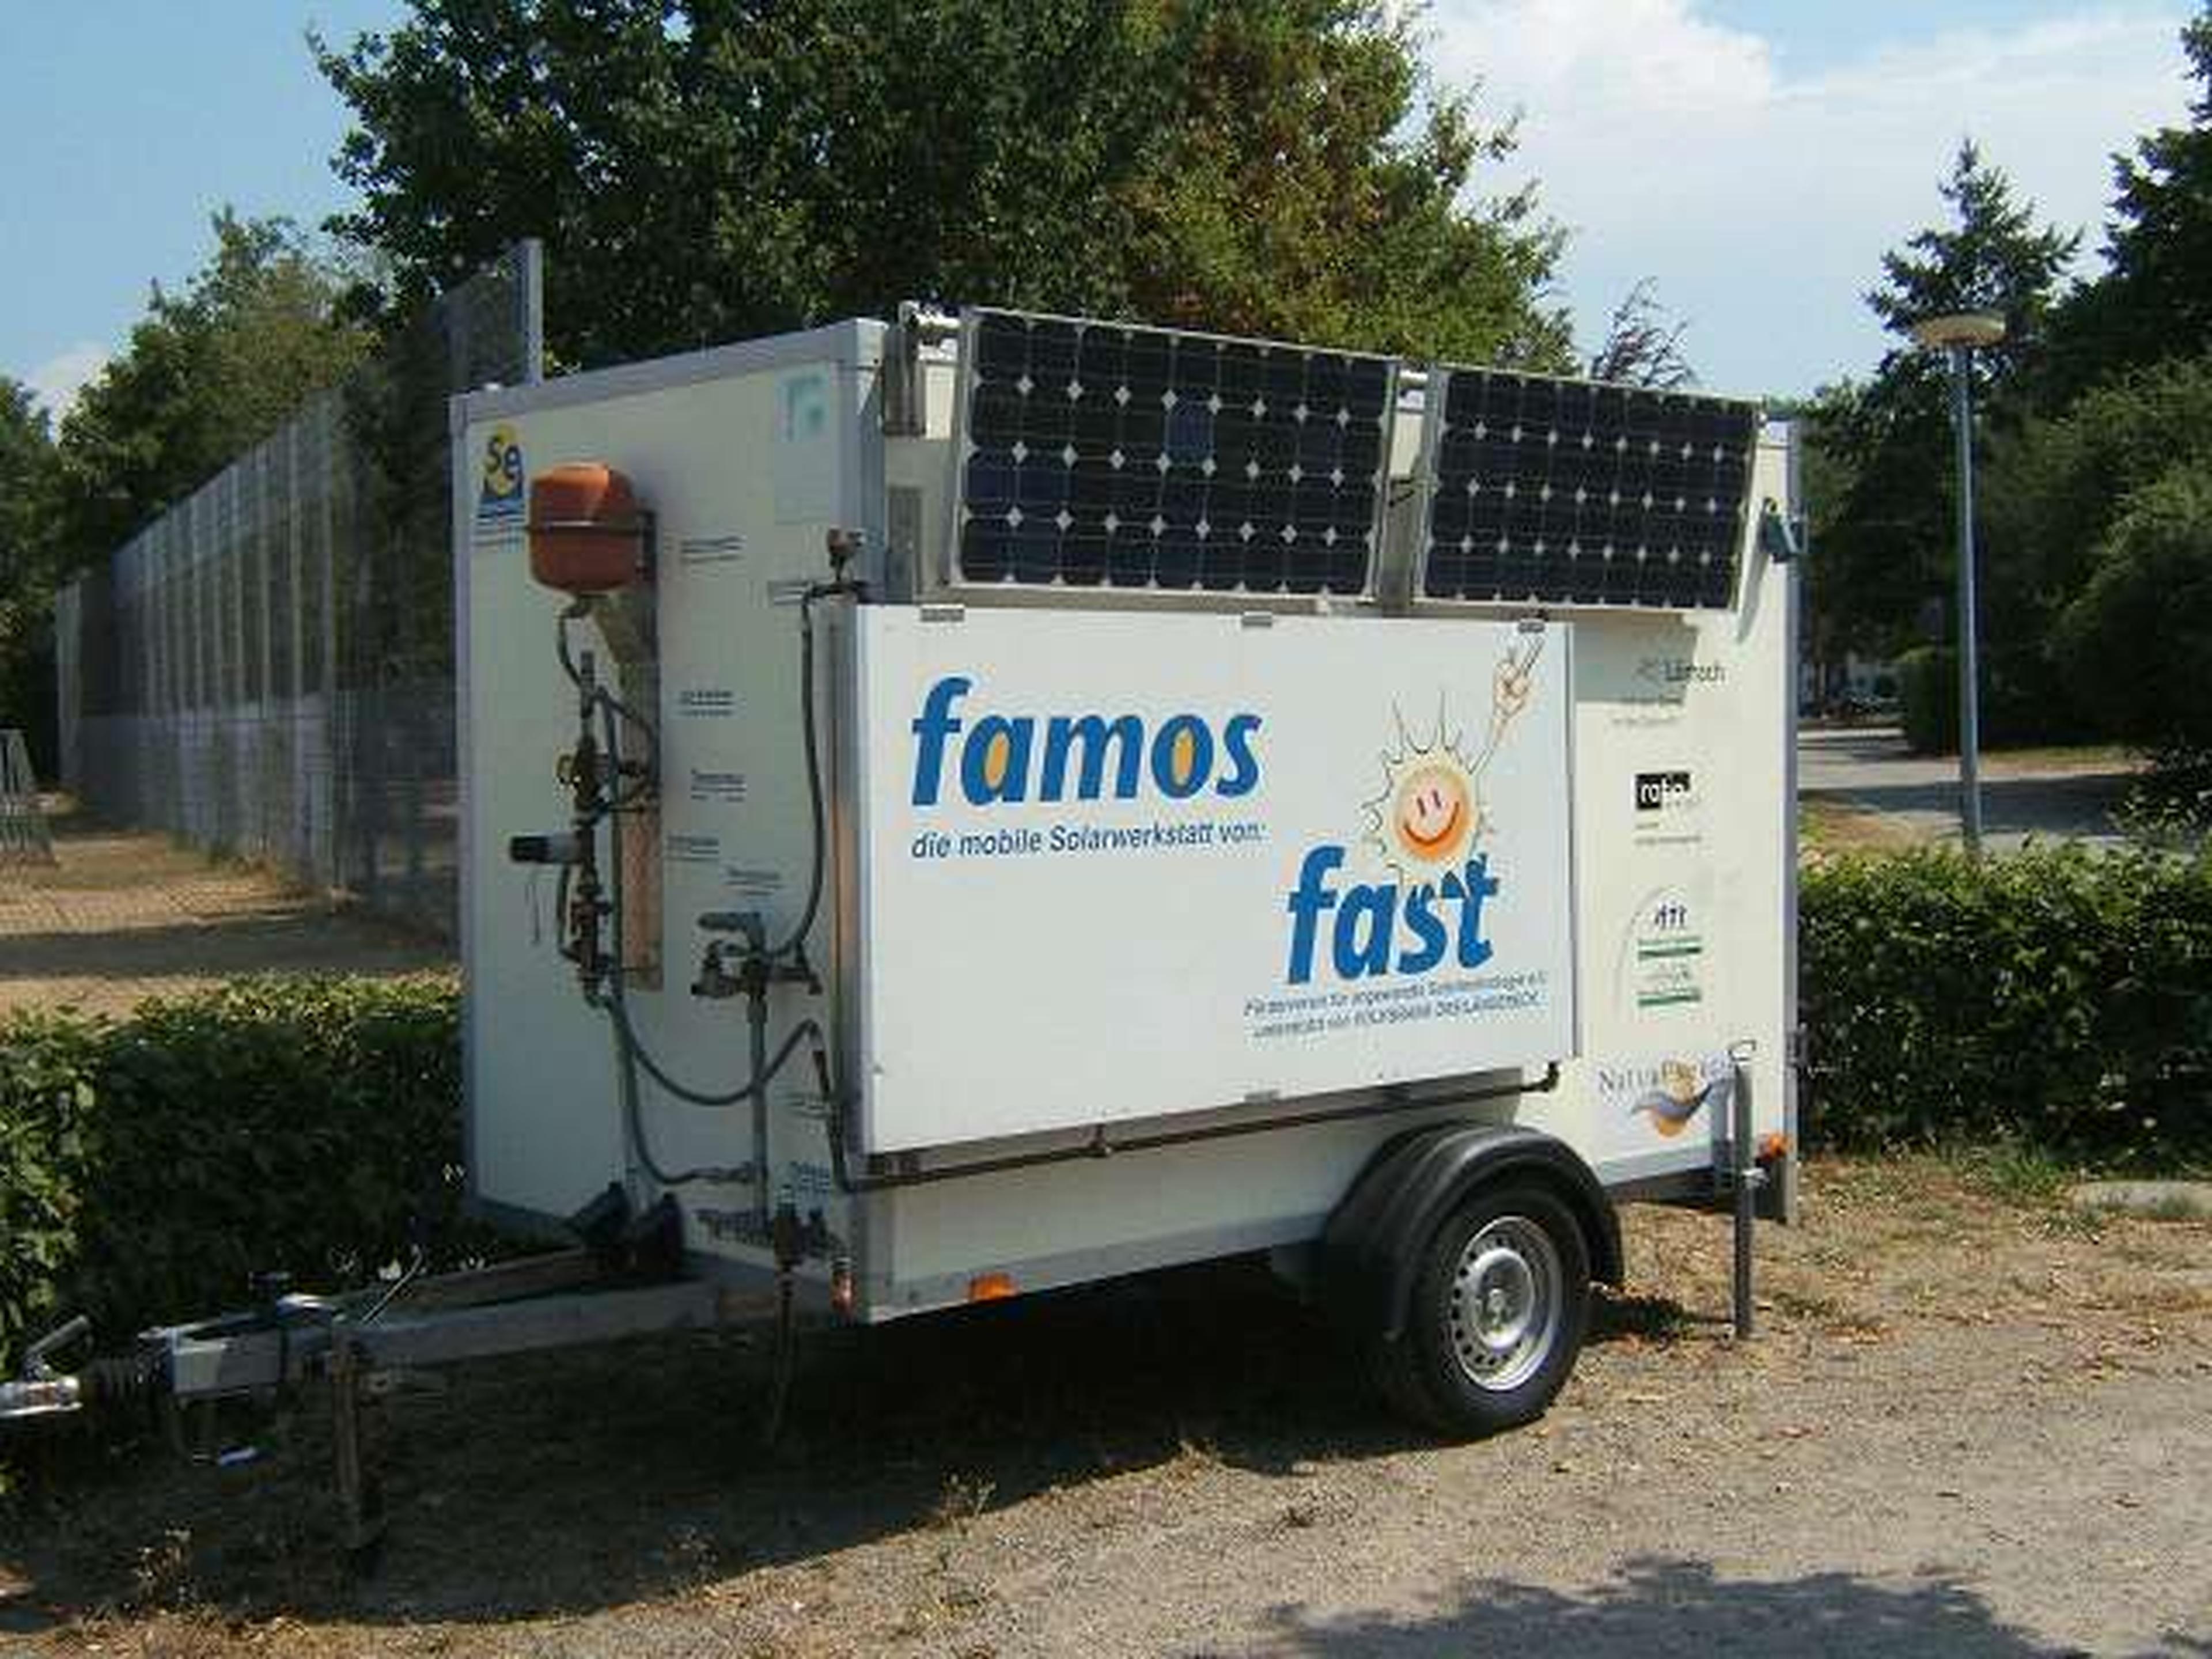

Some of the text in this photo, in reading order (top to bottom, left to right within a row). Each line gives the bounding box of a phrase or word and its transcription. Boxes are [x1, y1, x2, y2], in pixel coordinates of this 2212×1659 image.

[911, 676, 1263, 806] famos
[911, 835, 952, 858] die
[959, 827, 1042, 857] mobile
[1050, 822, 1215, 852] Solarwerkstatt
[1287, 844, 1499, 984] fast
